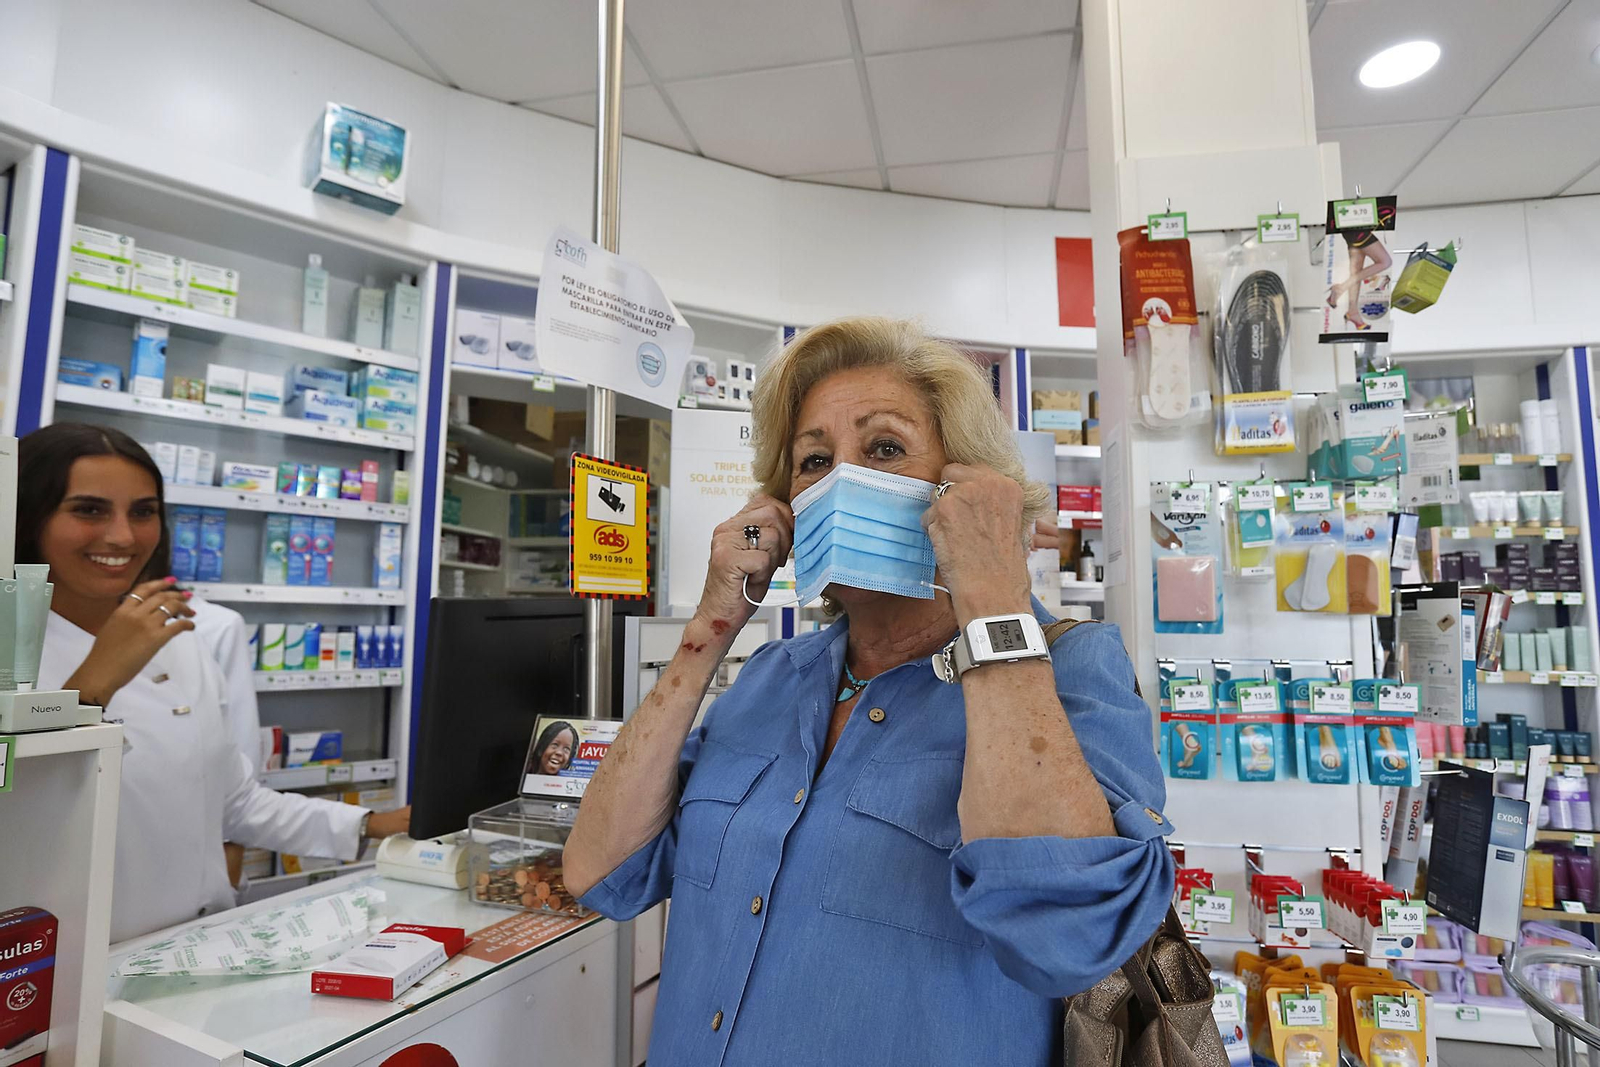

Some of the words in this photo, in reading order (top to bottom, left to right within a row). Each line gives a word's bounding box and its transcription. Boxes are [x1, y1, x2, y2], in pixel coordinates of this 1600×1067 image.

[562, 274, 575, 286] POR
[576, 280, 586, 291] LEY
[588, 286, 595, 294] ES
[597, 290, 637, 310] OBLIGATORIO
[640, 306, 646, 314] EL
[648, 308, 664, 318] USO
[666, 315, 676, 323] DE
[562, 286, 603, 306] MASCARILLA
[606, 302, 621, 313] PARA
[623, 309, 642, 322] ENTRAR
[656, 321, 671, 331] ESTE
[570, 300, 626, 325] ESTABLECIMIENTO
[627, 321, 657, 337] SANITARIO
[577, 461, 595, 472] ZONA
[597, 466, 645, 482] VIDEOVIGILADA
[714, 462, 746, 471] TRIPLE
[690, 473, 724, 482] SOLAR
[701, 487, 727, 496] PARA
[598, 529, 625, 548] ads
[589, 553, 602, 561] 959
[1000, 624, 1013, 649] 12:42
[31, 704, 61, 713] Nuevo
[1408, 800, 1420, 841] STOPDOL
[1497, 812, 1523, 824] EXDOL
[1211, 902, 1226, 910] 3,95
[0, 967, 28, 980] Forte
[1395, 1009, 1410, 1017] 3,90
